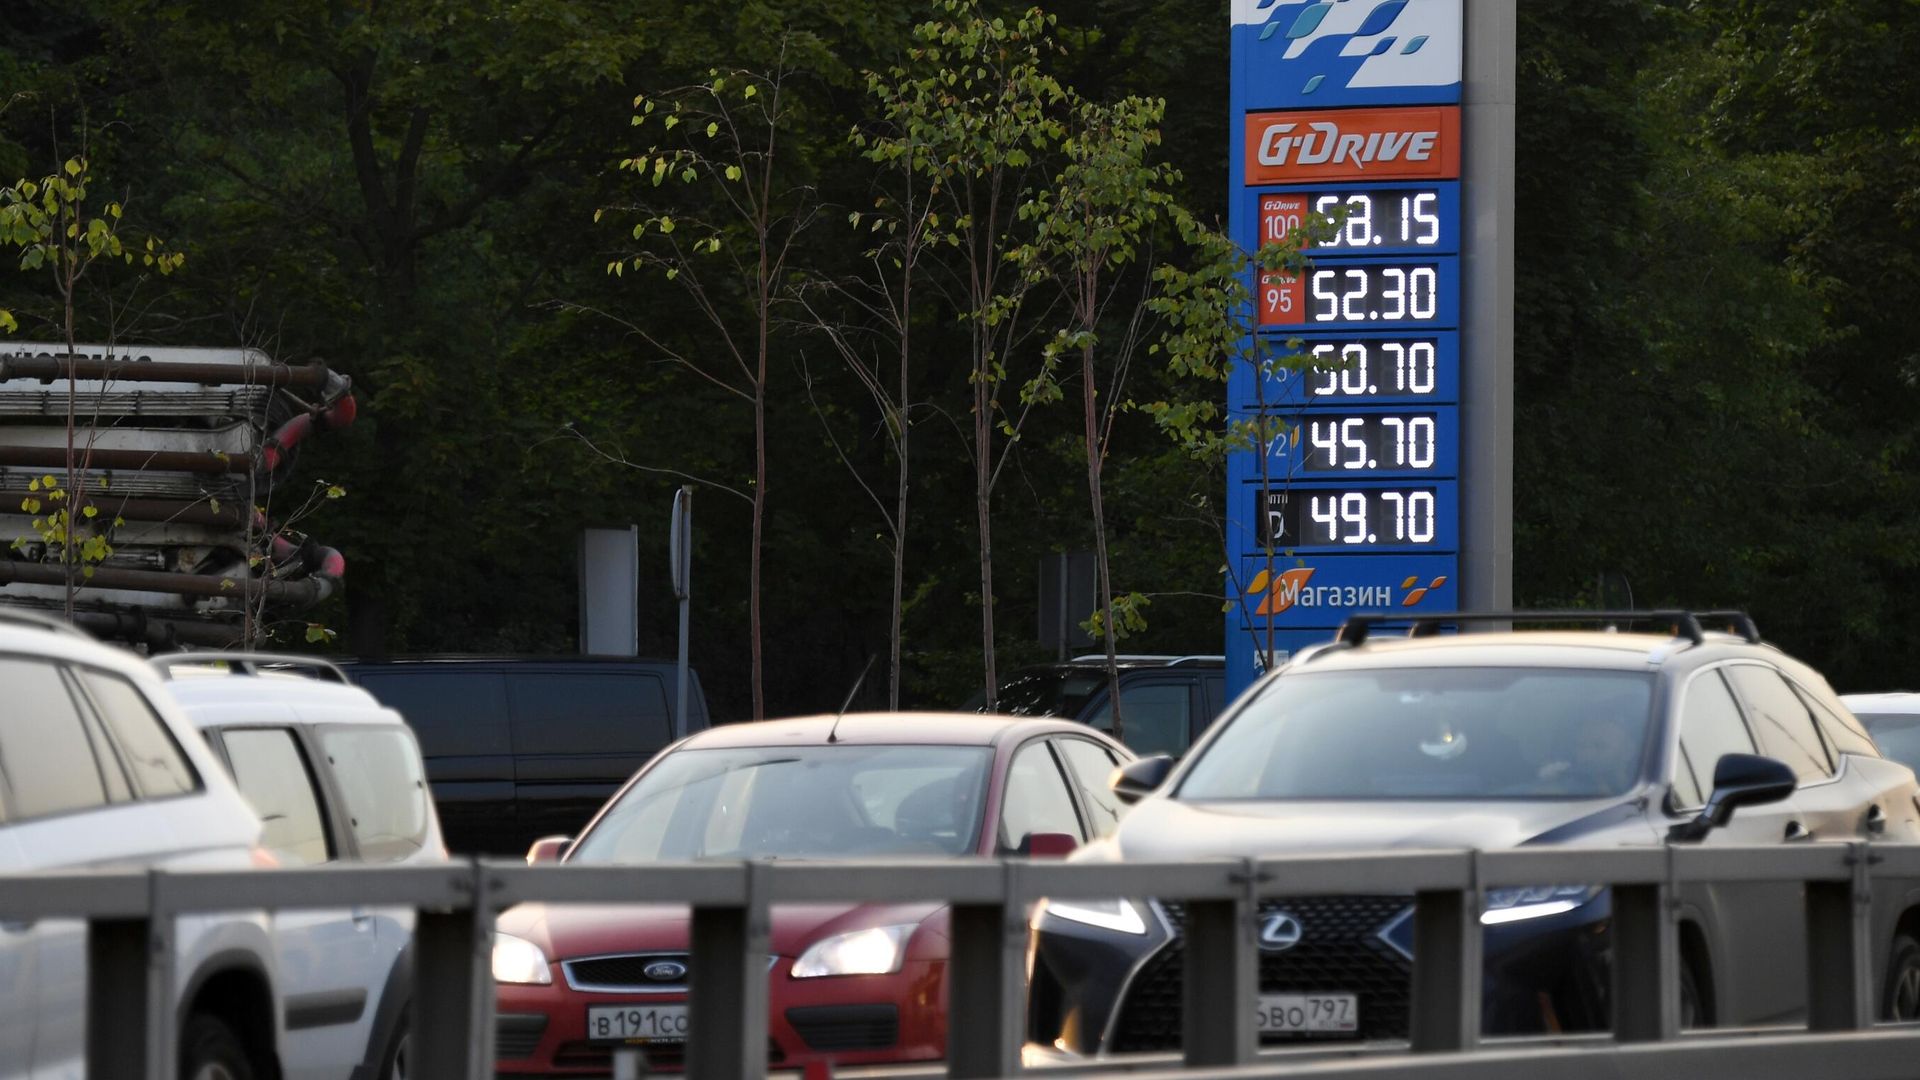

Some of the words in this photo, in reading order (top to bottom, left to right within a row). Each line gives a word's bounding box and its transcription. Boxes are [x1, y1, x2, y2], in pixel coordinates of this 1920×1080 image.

[1257, 121, 1438, 169] G-DRIVE
[1265, 215, 1299, 239] 100
[1316, 193, 1439, 246] 58.15
[1267, 288, 1292, 312] 95
[1312, 268, 1436, 321] 52.30
[1312, 342, 1434, 395] 50.70
[1311, 417, 1434, 469] 45.70
[1311, 491, 1434, 544] 49.70
[1280, 578, 1391, 607] Магазин
[1309, 998, 1349, 1020] 797
